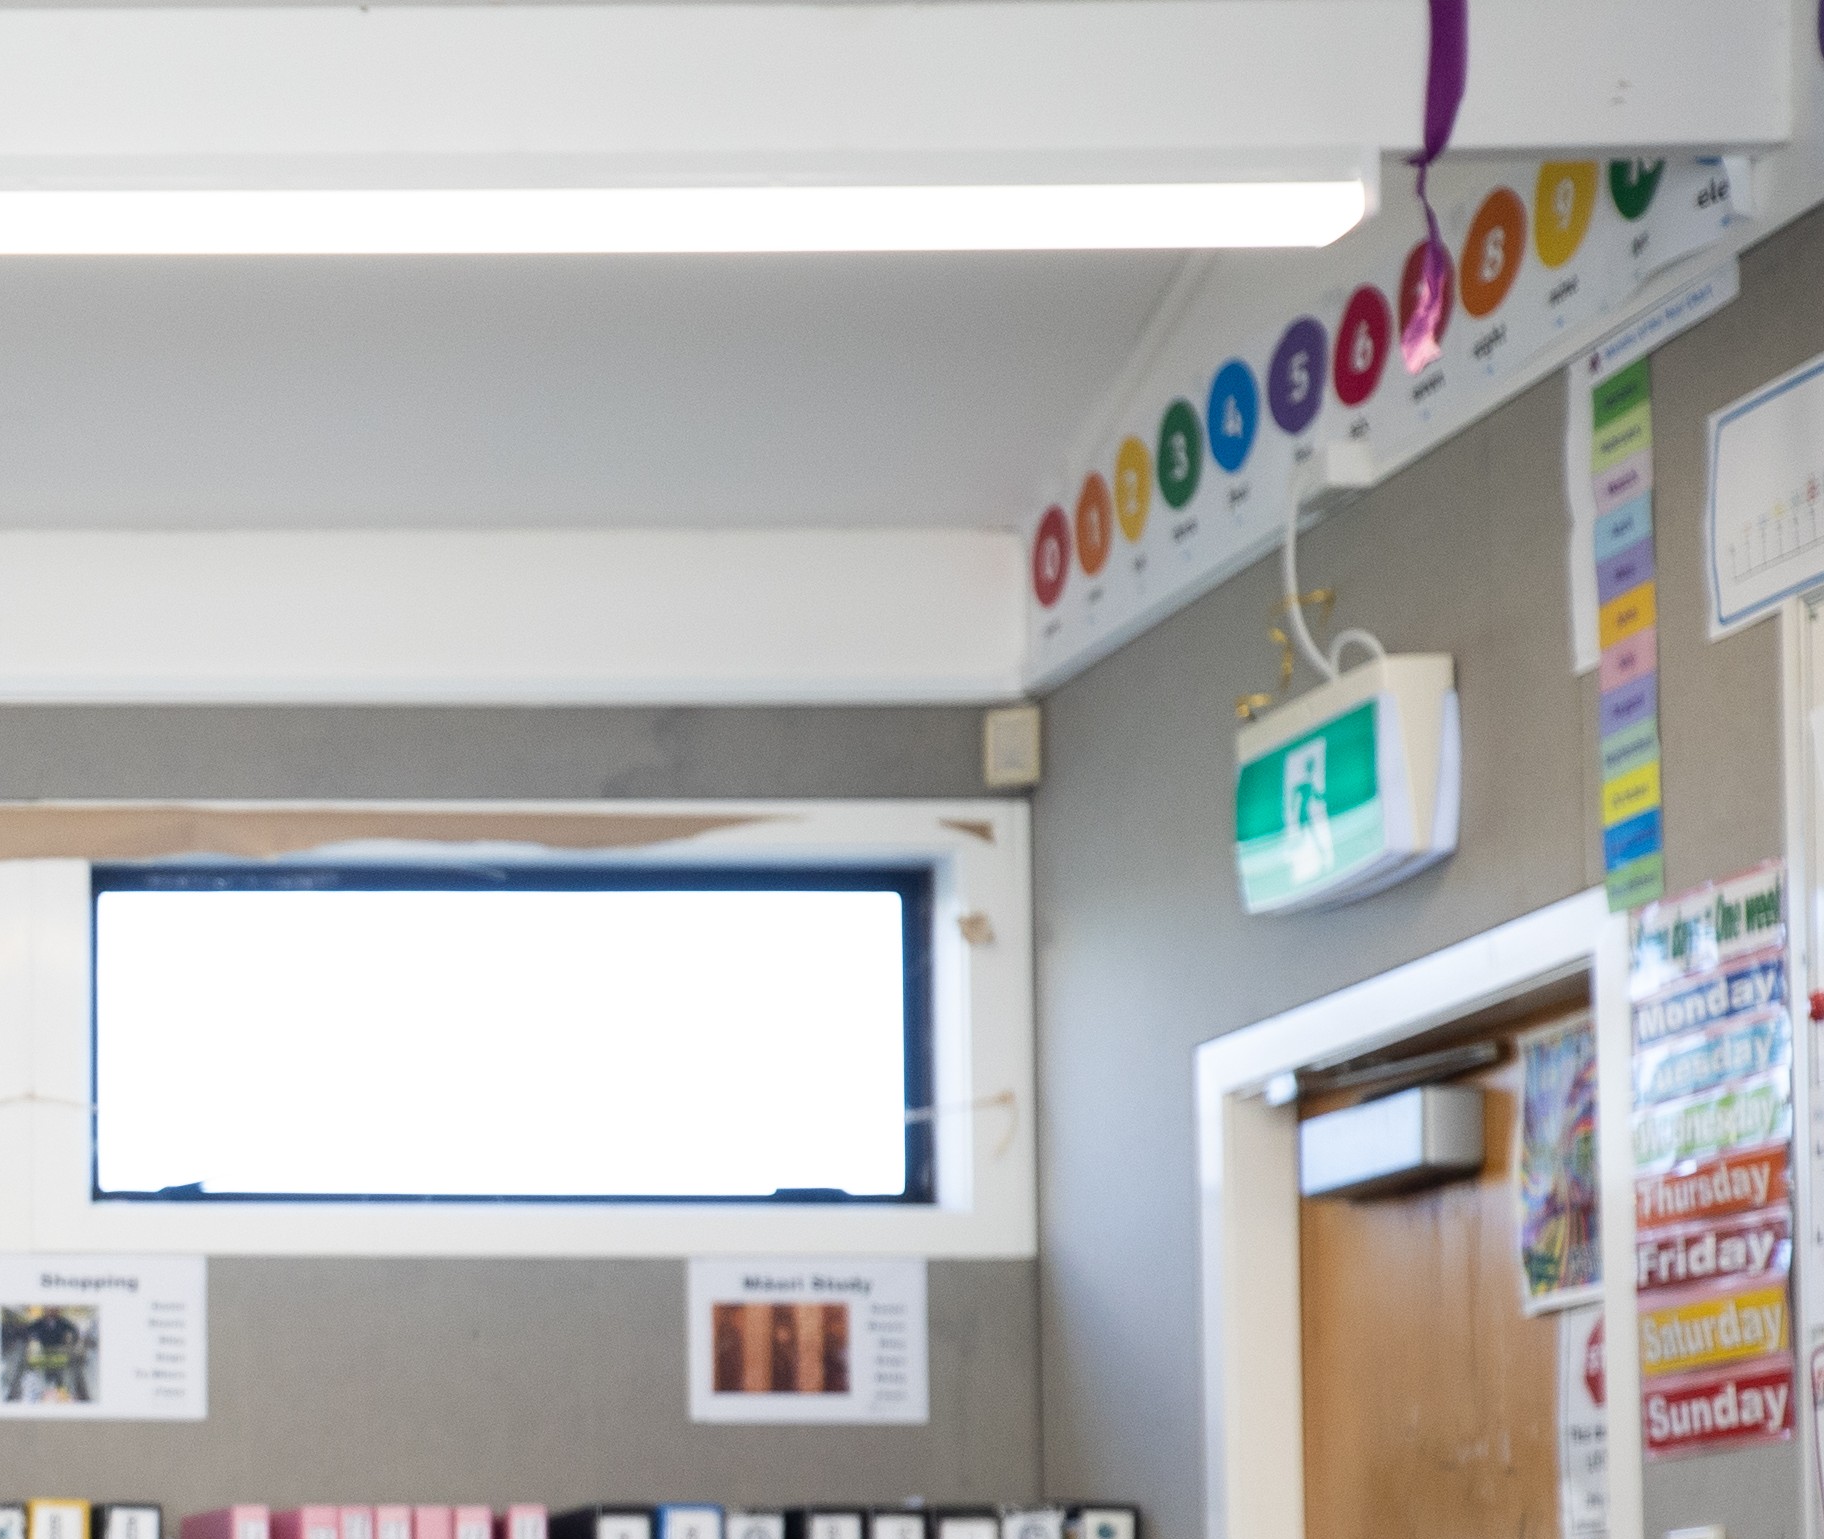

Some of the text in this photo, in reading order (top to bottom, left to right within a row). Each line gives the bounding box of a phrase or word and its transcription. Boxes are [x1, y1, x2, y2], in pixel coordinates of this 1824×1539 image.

[1556, 176, 1575, 228] 9
[1352, 321, 1374, 372] 6
[1288, 350, 1310, 408] 5
[1222, 394, 1243, 438] 4
[1173, 432, 1187, 482] 3
[1043, 536, 1060, 580] 0
[1639, 968, 1776, 1042] Monday
[1642, 1021, 1775, 1093] uesday
[1638, 1160, 1770, 1218] Thursday
[40, 1274, 139, 1292] Shopping
[1638, 1229, 1775, 1286] Friday
[1642, 1302, 1783, 1361] Saturday
[1650, 1383, 1789, 1438] Sunday
